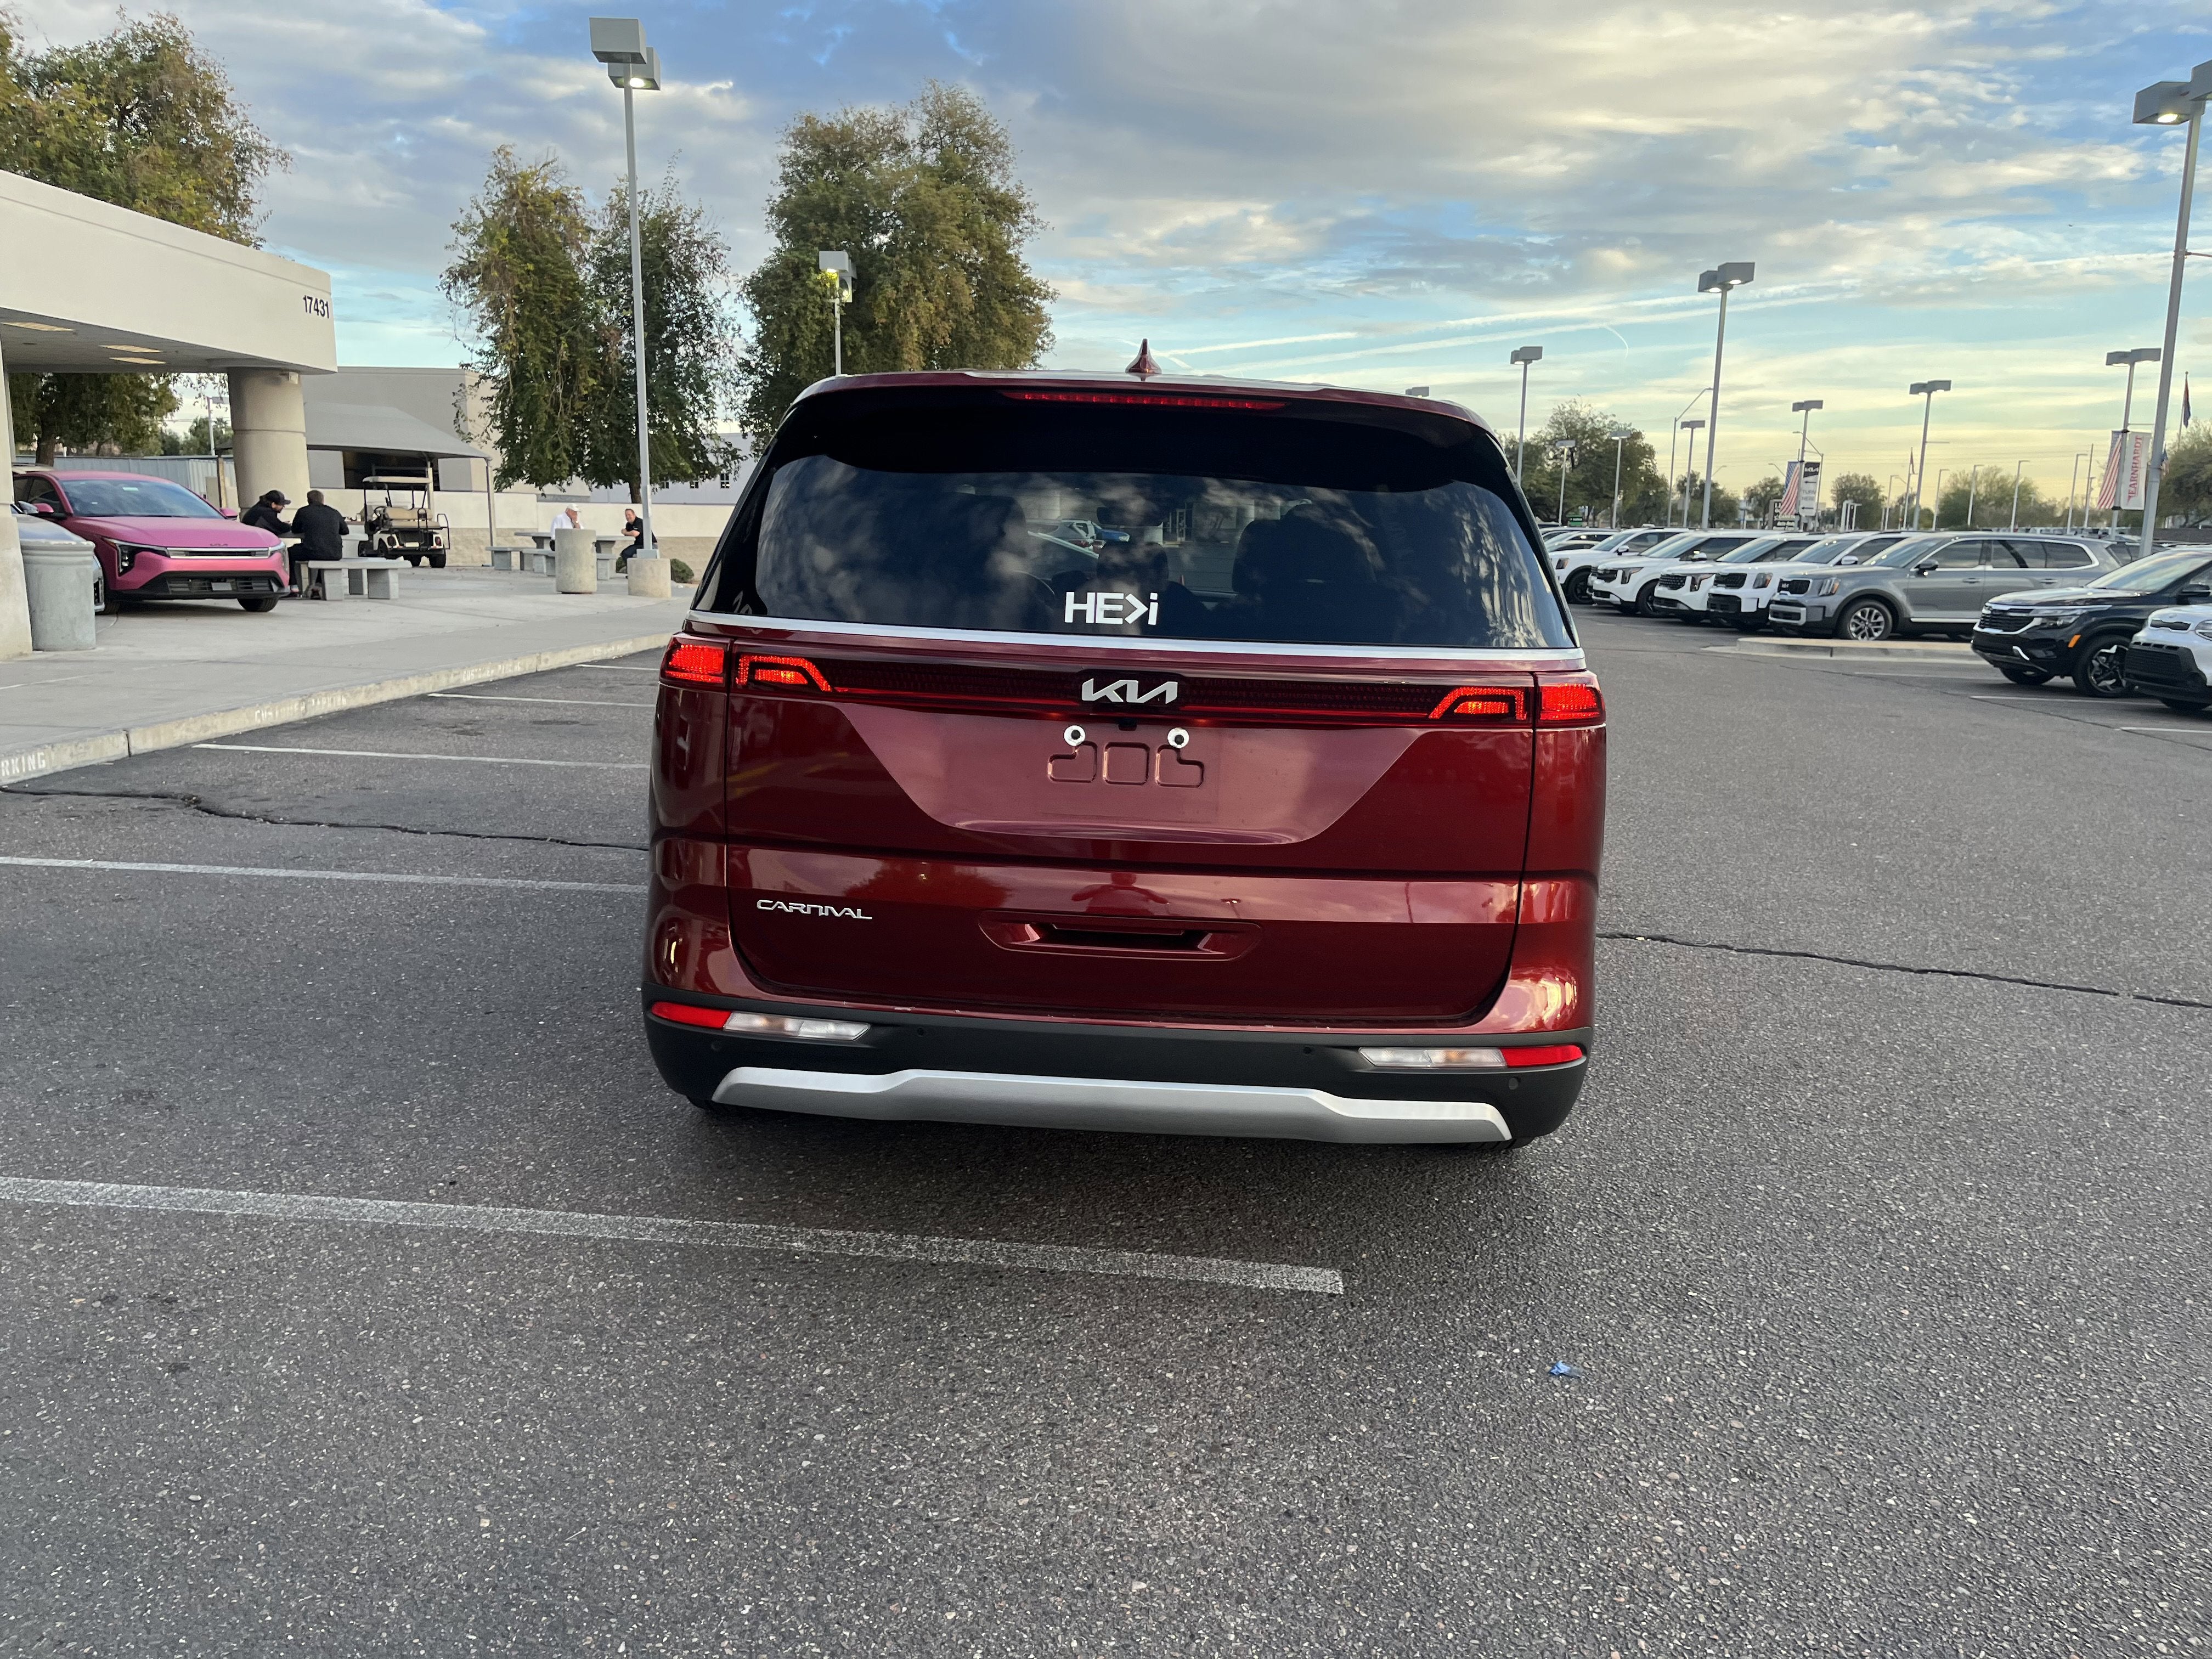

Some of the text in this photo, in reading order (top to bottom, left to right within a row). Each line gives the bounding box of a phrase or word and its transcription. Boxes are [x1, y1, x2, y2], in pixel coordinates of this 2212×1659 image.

[303, 295, 329, 319] 17431
[2128, 435, 2142, 502] EARNHARDT
[1082, 678, 1178, 704] KIA
[1, 752, 46, 777] RKING
[757, 899, 873, 920] CARNIVAL
